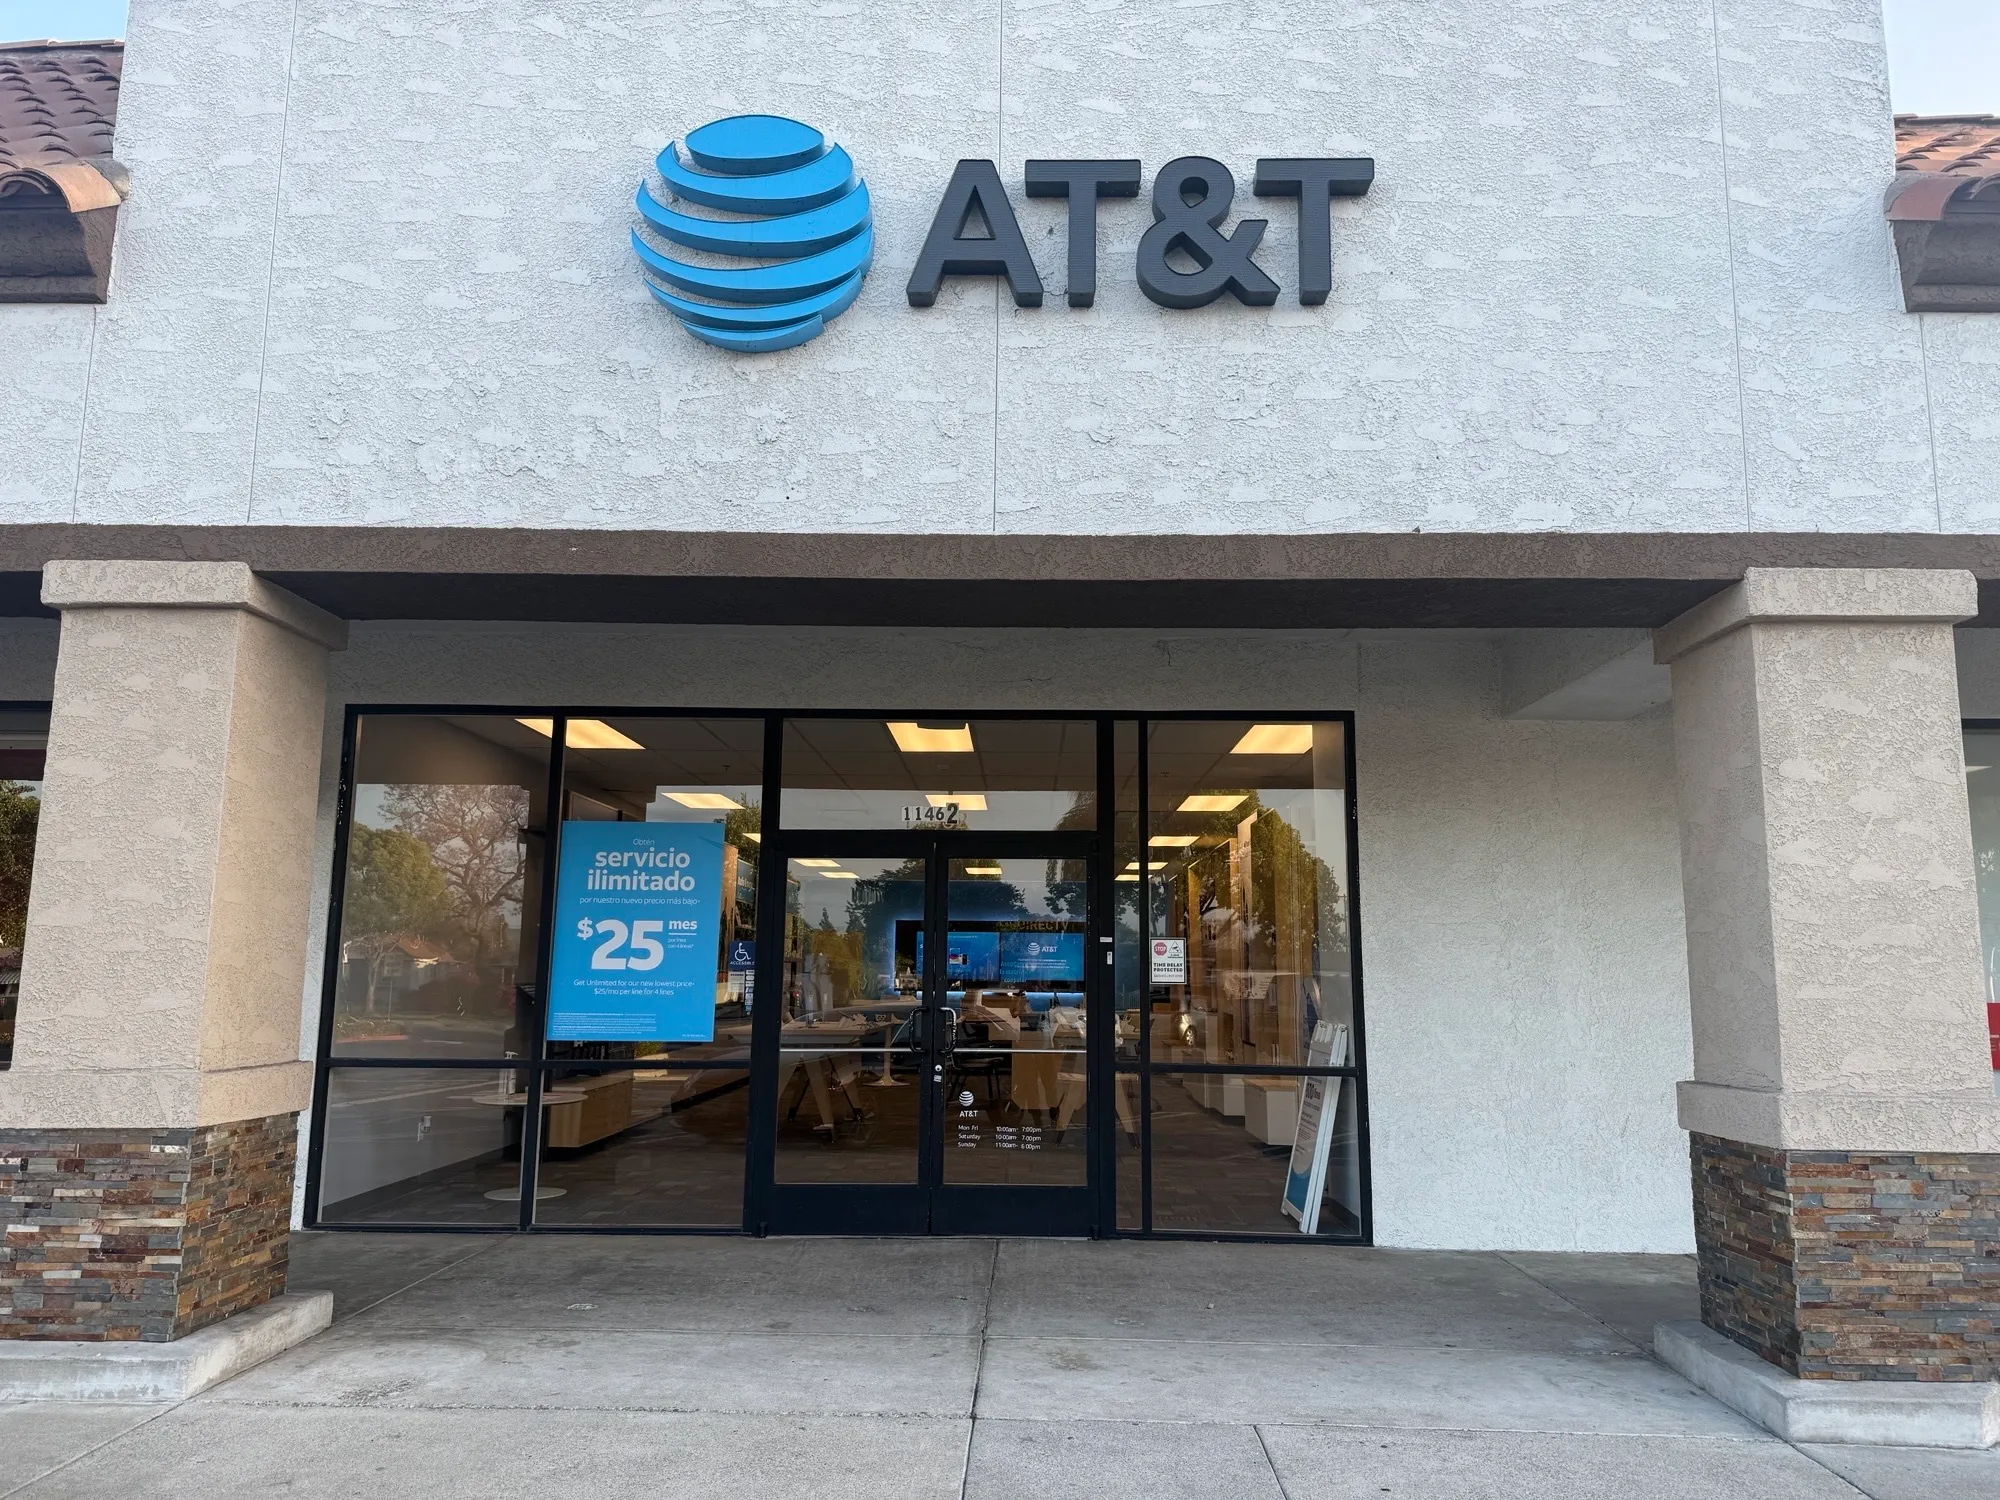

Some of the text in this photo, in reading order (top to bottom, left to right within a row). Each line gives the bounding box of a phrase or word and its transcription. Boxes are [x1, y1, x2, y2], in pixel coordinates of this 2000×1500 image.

[906, 155, 1375, 309] AT&T
[904, 803, 958, 824] 11462
[594, 847, 690, 868] servicio
[587, 869, 696, 892] ilimitado
[644, 897, 666, 906] precio
[1018, 920, 1069, 930] DIRECTV
[576, 917, 698, 970] $25 mes
